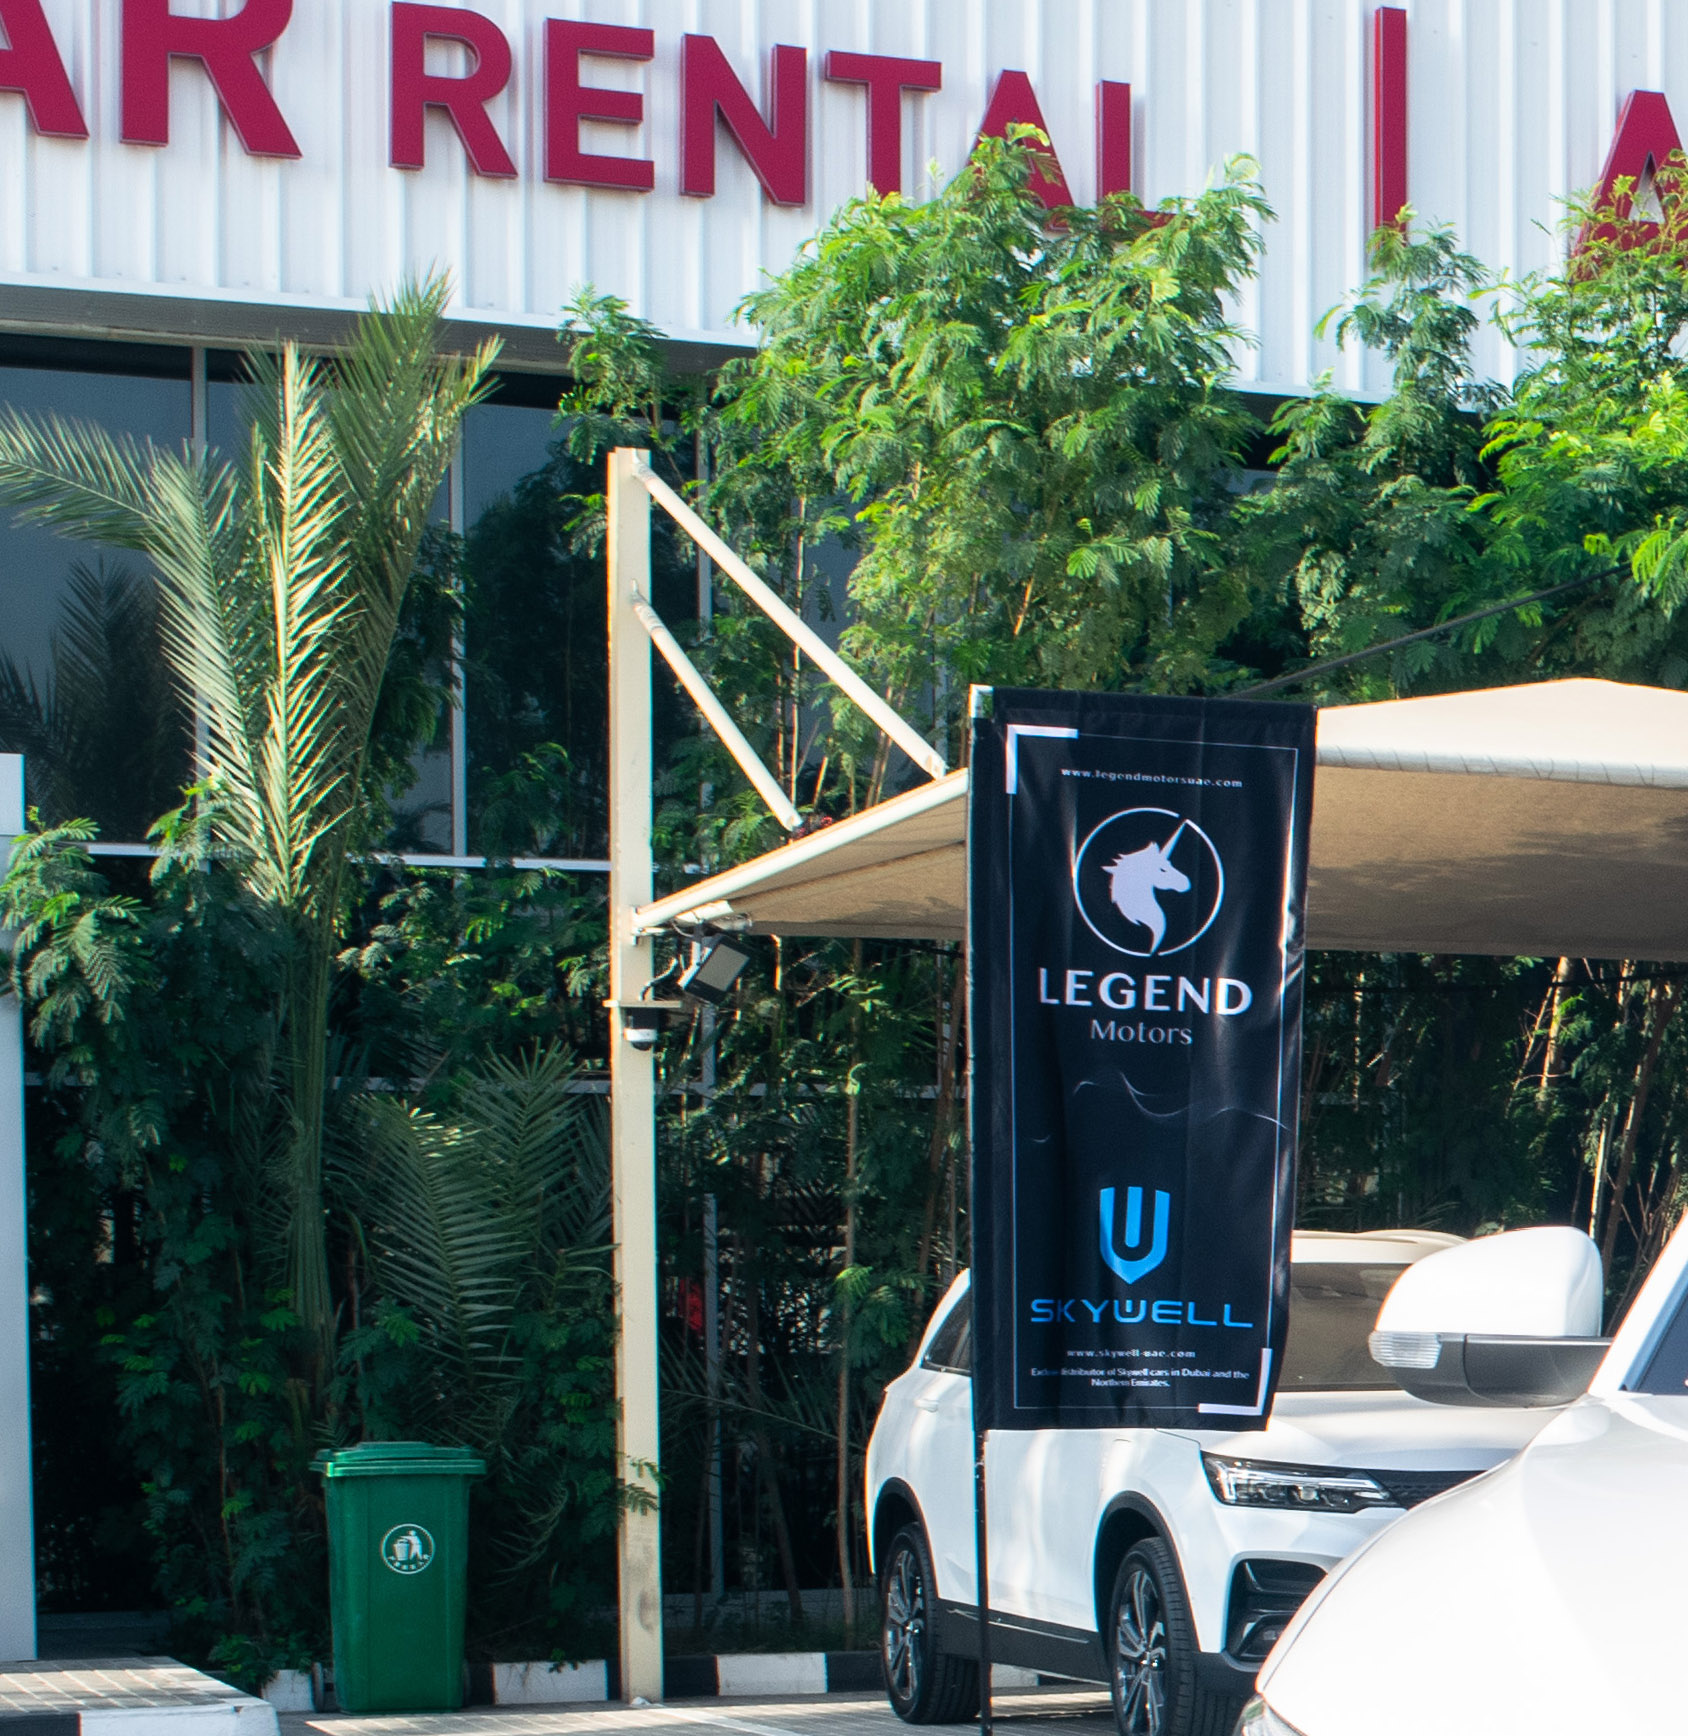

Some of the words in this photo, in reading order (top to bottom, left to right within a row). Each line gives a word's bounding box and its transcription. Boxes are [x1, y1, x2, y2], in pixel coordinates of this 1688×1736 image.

[390, 1, 1187, 236] RENTAL
[1060, 767, 1244, 789] www.legendmotorsuae.com
[1039, 967, 1253, 1016] LEGEND
[1090, 1019, 1193, 1046] Motors
[1030, 1298, 1254, 1328] SKYWELL
[1181, 1367, 1211, 1378] Dubai
